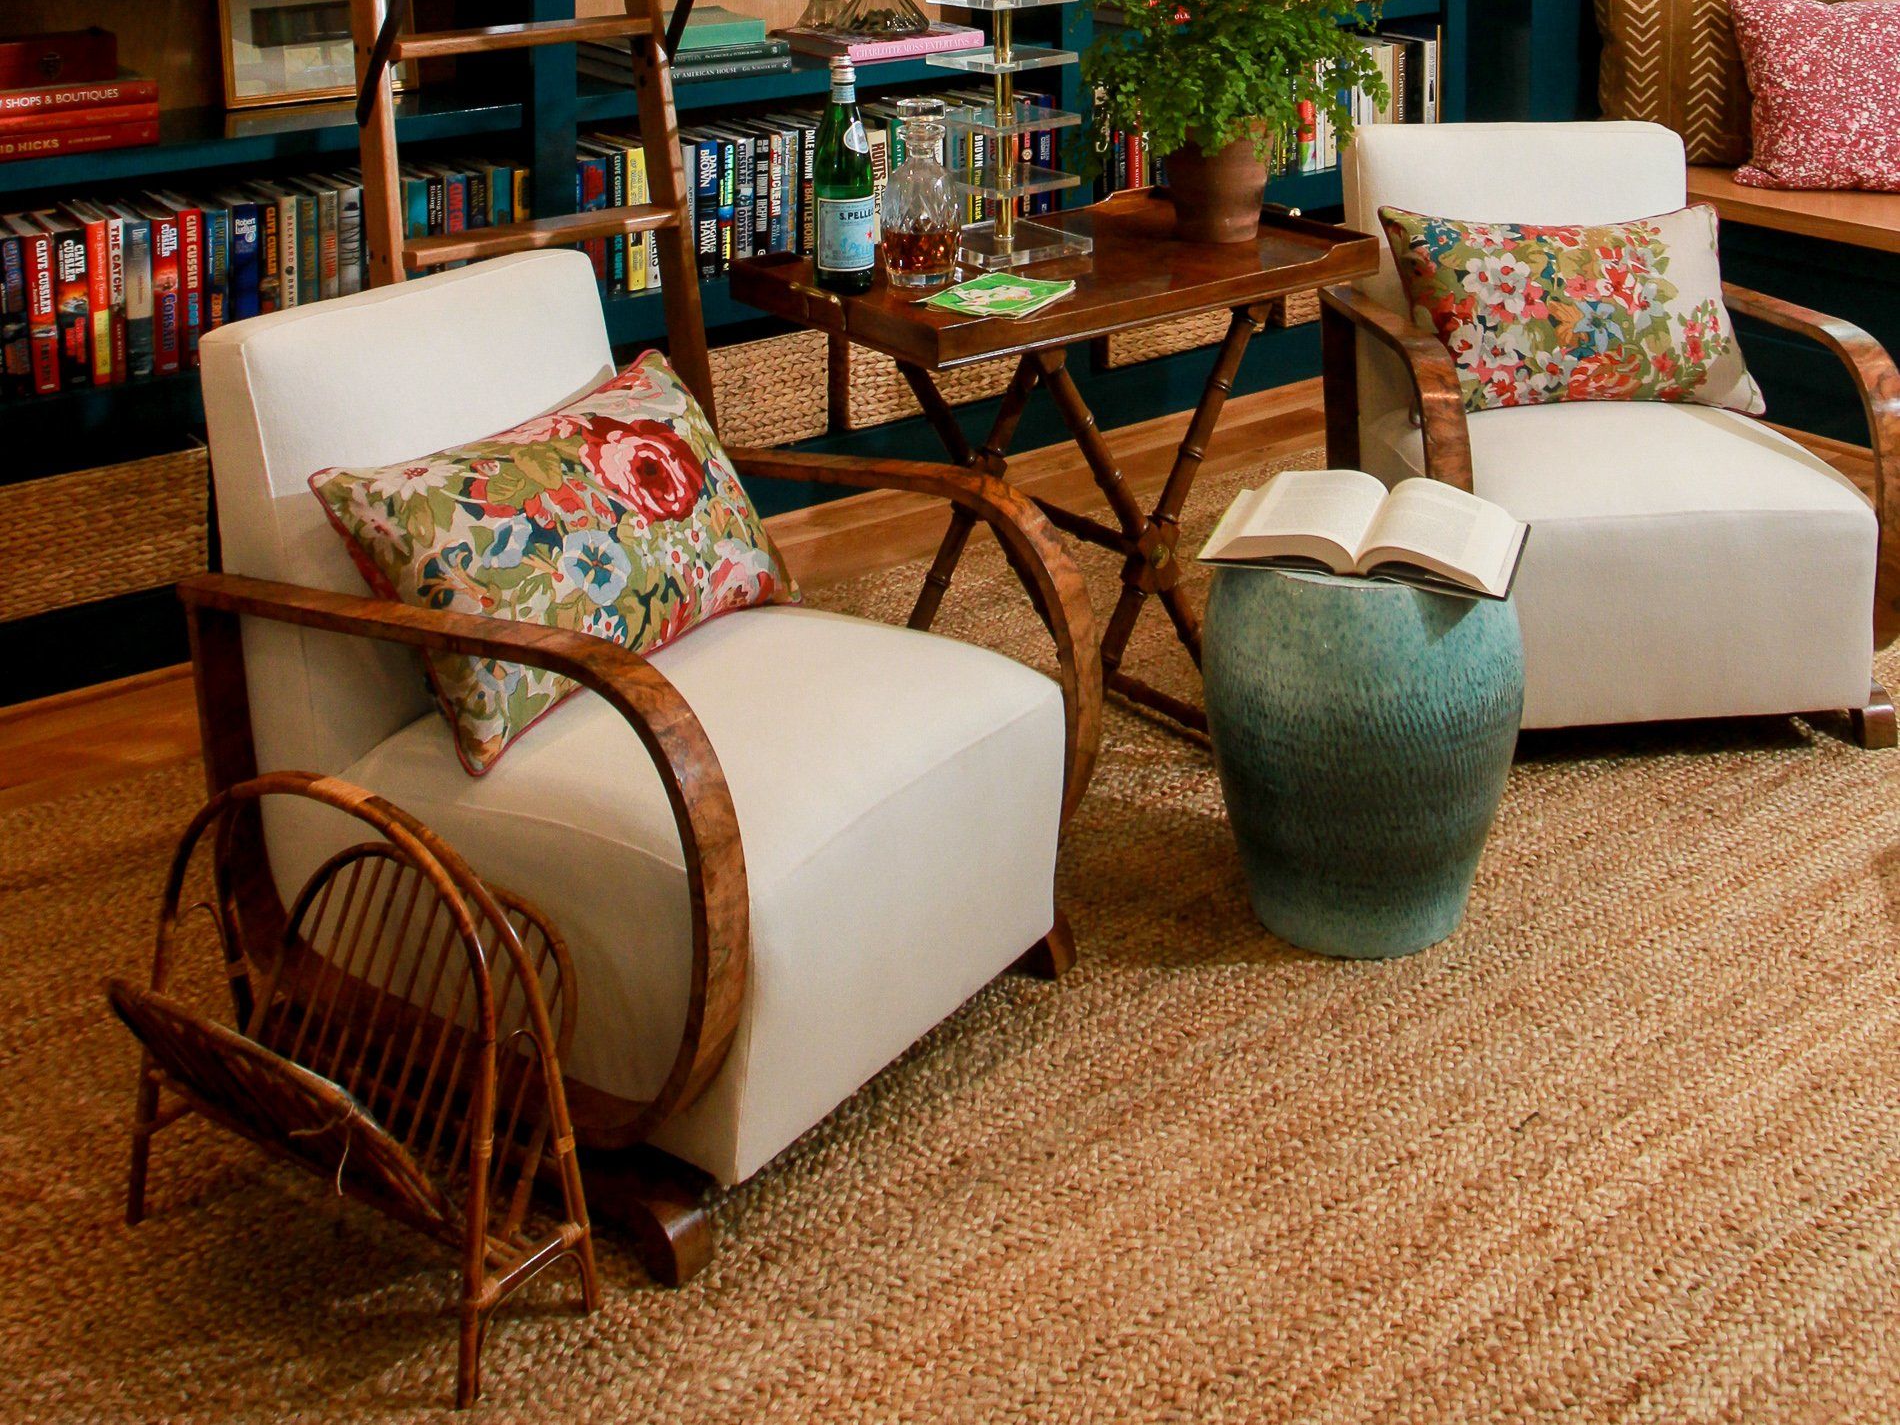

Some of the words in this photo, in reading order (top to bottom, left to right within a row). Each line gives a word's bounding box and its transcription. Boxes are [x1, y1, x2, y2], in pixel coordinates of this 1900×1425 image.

[856, 46, 901, 57] CHARLOTTE
[903, 44, 923, 52] MOSS
[925, 38, 970, 51] ENTERTAINS
[682, 70, 715, 78] AMERICAN
[6, 96, 41, 109] SHOPS
[45, 95, 52, 104] &
[56, 88, 119, 103] BOUTIQUES
[1396, 73, 1405, 121] Greenspan
[18, 139, 60, 152] HICKS
[806, 129, 815, 149] DALE
[974, 135, 983, 167] BROWN
[700, 149, 710, 188] BROWN
[709, 155, 717, 179] DALE
[725, 145, 733, 170] CLIVE
[738, 143, 746, 185] CUSSLER
[804, 150, 814, 179] BROWN
[871, 142, 886, 181] ROOTS
[725, 170, 733, 205] CUSSLER
[804, 188, 813, 221] BATTLE
[974, 195, 982, 220] Attack
[186, 214, 197, 243] CLIVE
[266, 207, 276, 234] CLIVE
[737, 209, 746, 252] ODYSSEY
[803, 223, 813, 249] BORN
[110, 226, 120, 251] THE
[286, 215, 294, 263] BACKYARD
[700, 221, 711, 254] HAWK
[36, 239, 48, 270] CLIVE
[63, 239, 76, 283] CUSSLER
[74, 244, 86, 274] CLIVE
[186, 246, 198, 289] CUSSLER
[112, 253, 122, 293] CATCH
[38, 271, 51, 315] CUSSLER
[162, 293, 178, 352] CORSAIR
